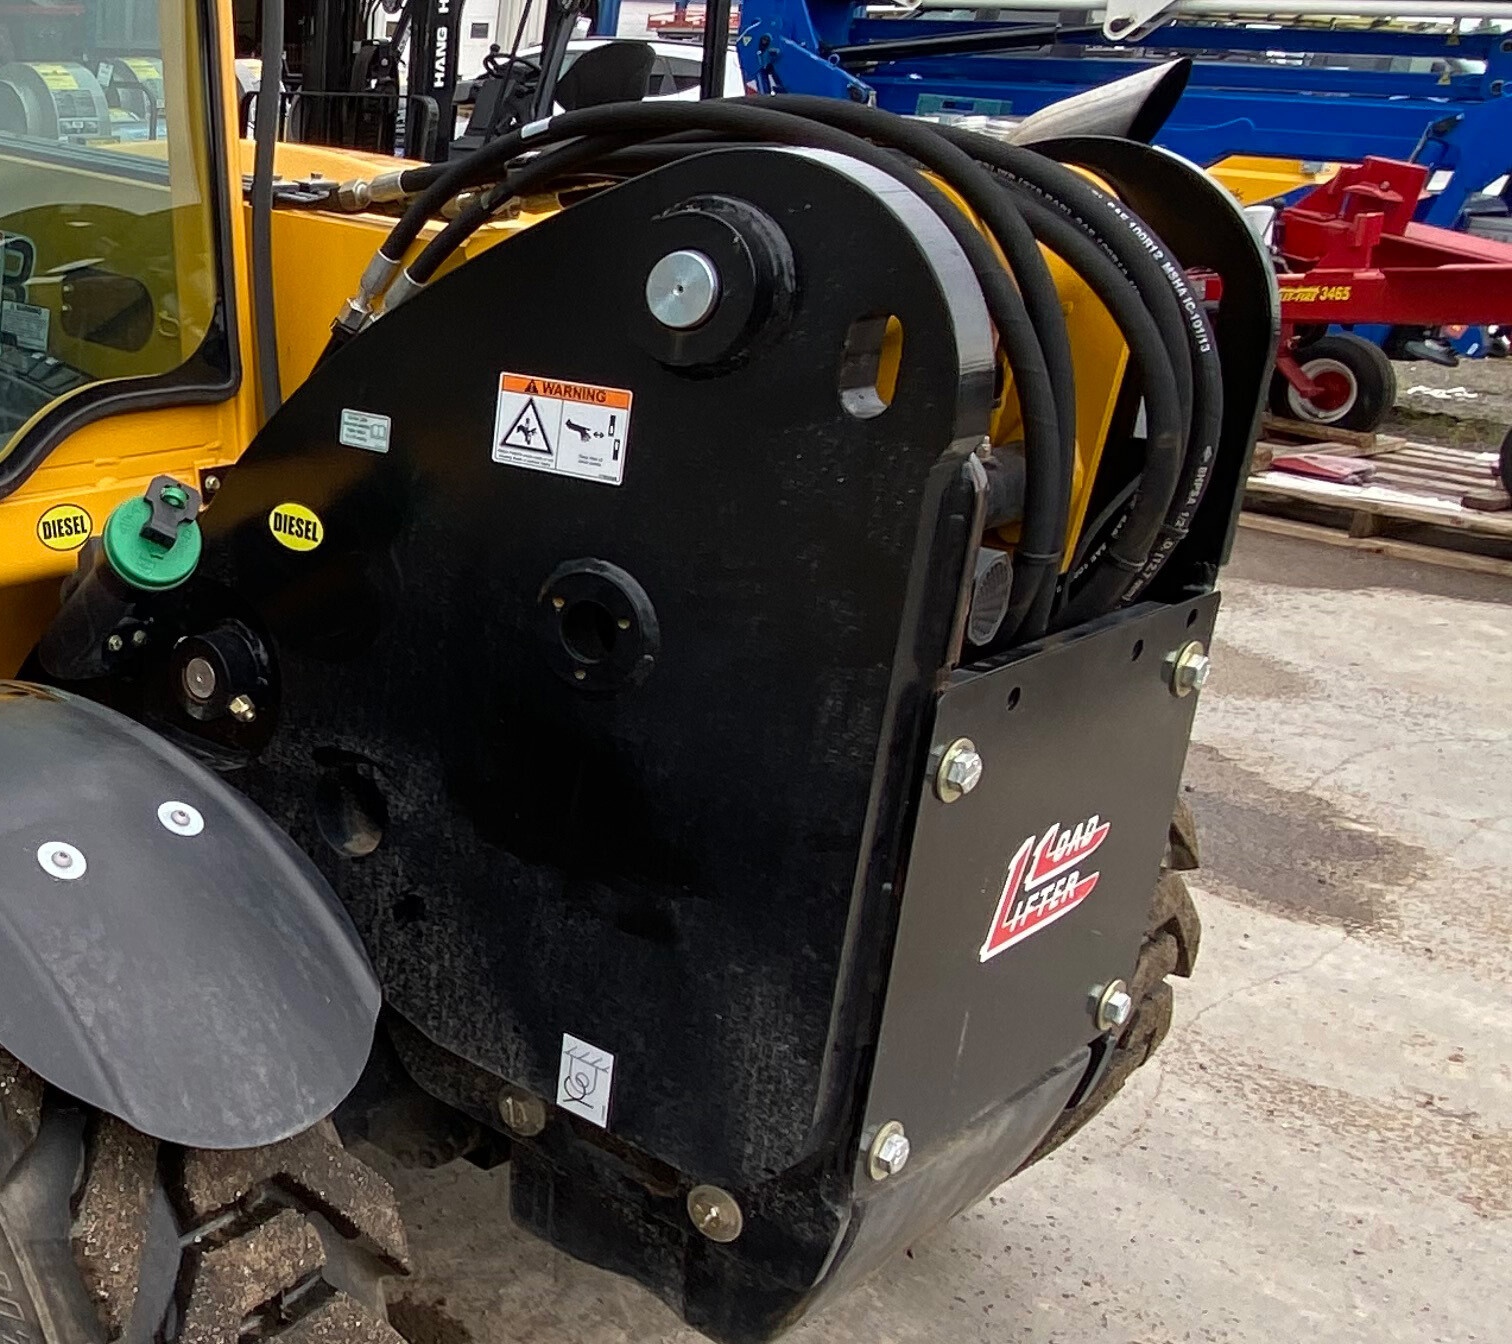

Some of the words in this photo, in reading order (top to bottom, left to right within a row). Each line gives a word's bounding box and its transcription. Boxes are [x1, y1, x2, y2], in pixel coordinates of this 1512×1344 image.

[542, 380, 607, 403] WARNING
[41, 514, 88, 541] DIESEL
[272, 512, 320, 544] DIESEL
[1024, 813, 1111, 893] LOAD
